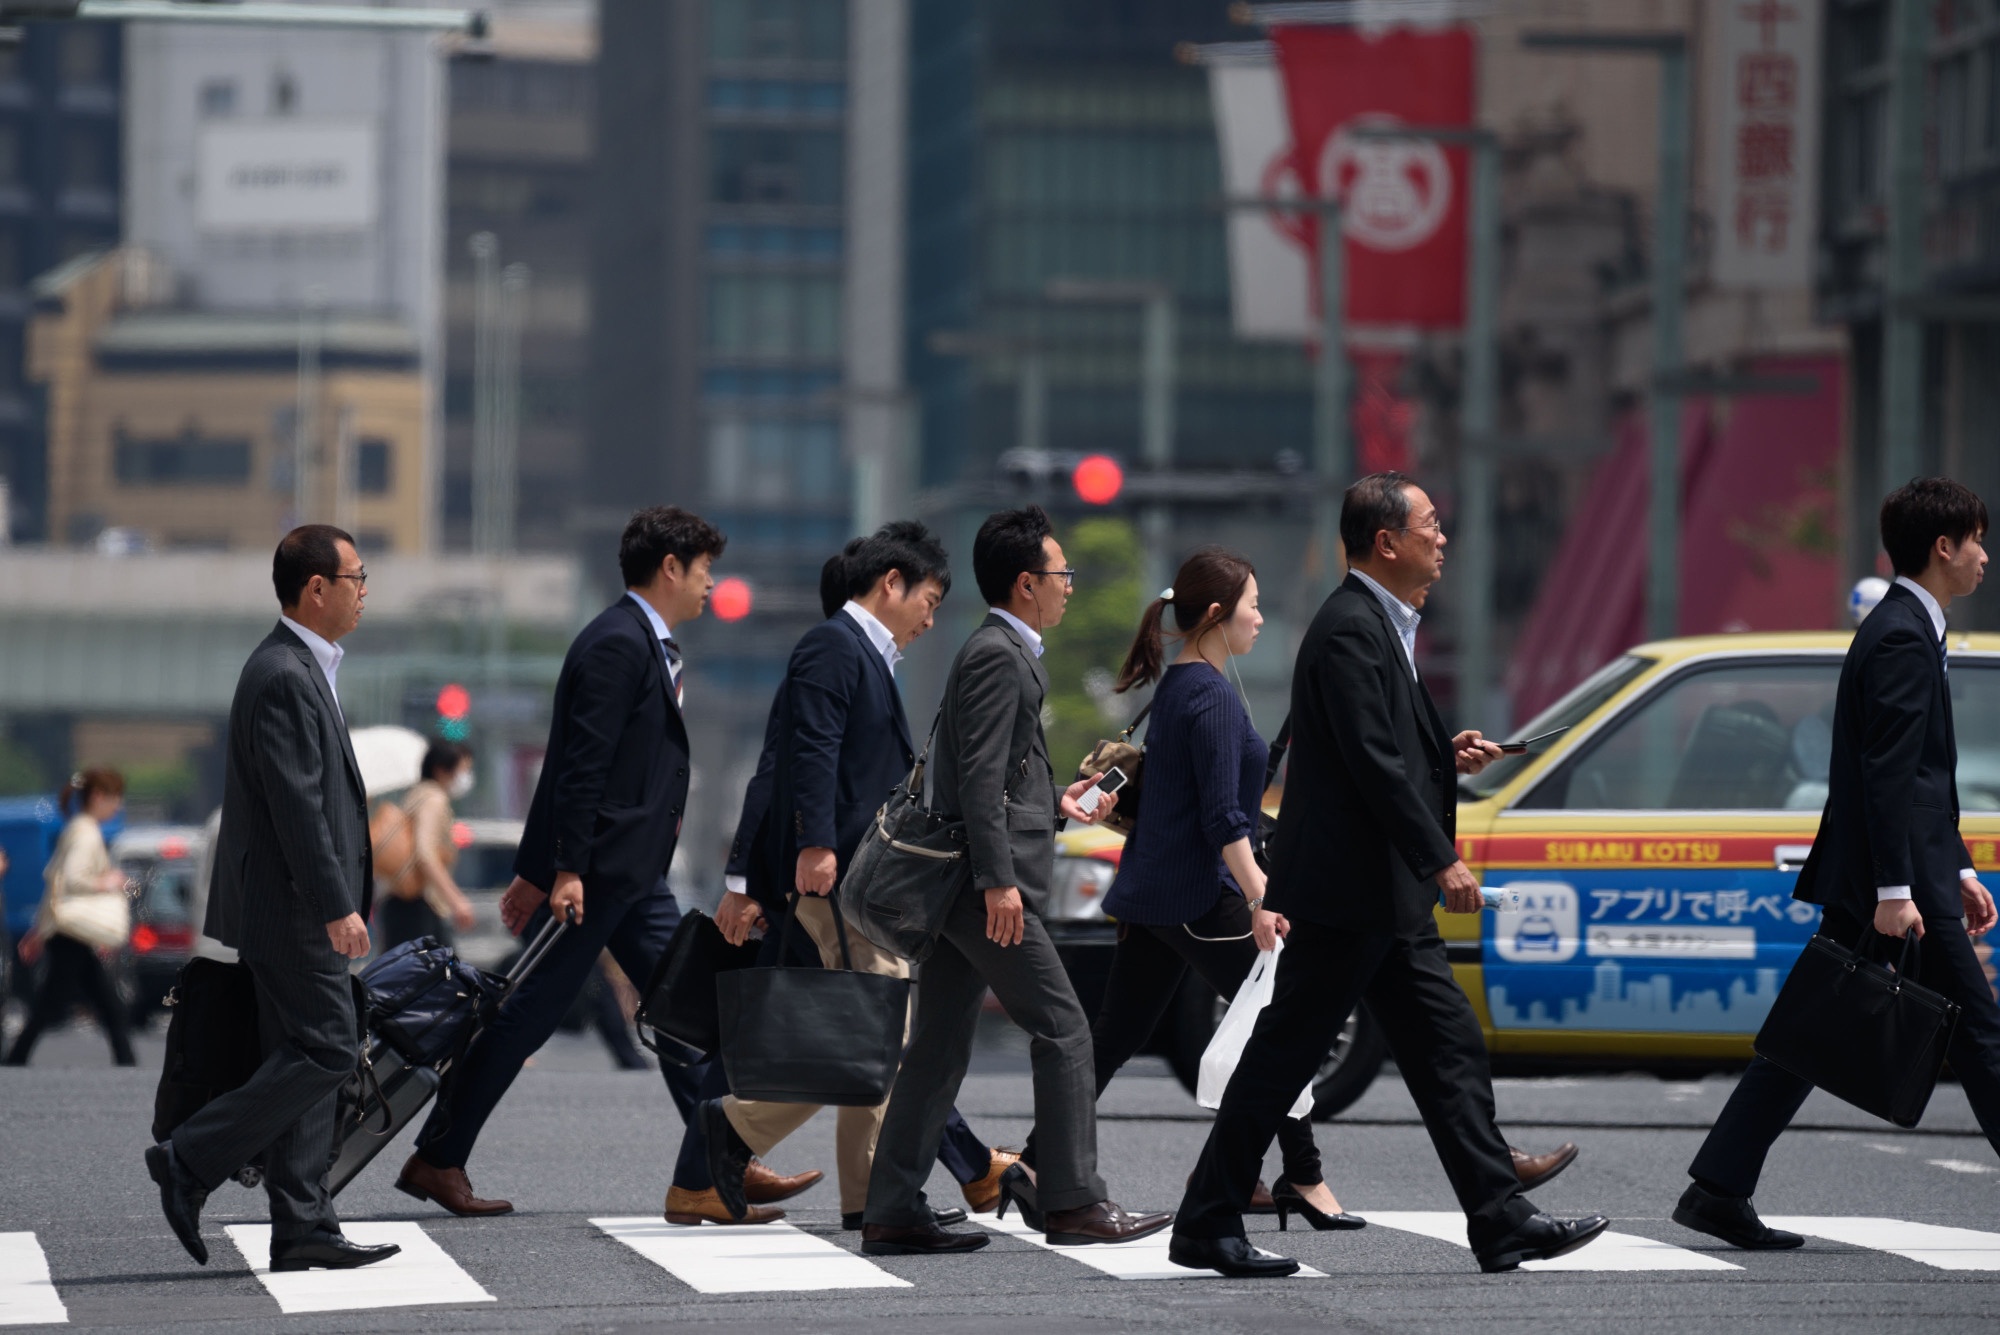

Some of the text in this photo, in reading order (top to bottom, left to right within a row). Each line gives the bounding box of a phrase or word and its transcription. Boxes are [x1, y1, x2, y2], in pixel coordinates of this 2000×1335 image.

[1546, 841, 1719, 862] SUBARU KOTSU
[1523, 896, 1567, 910] AXI
[1590, 888, 1824, 924] アプリで呼べる
